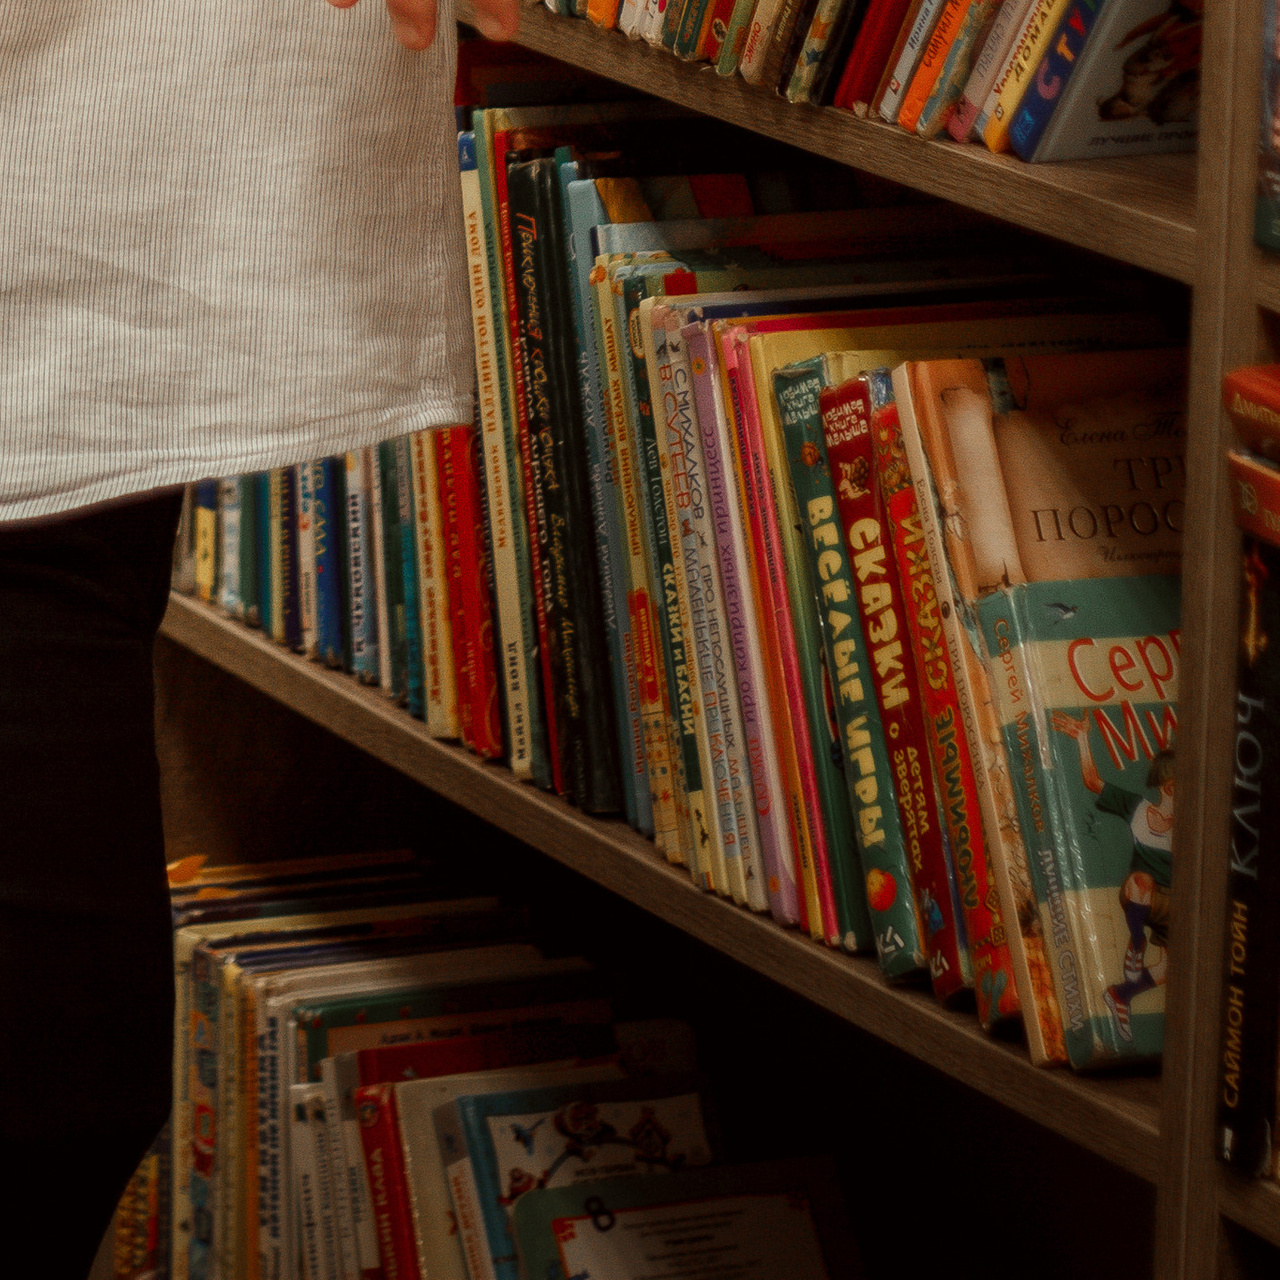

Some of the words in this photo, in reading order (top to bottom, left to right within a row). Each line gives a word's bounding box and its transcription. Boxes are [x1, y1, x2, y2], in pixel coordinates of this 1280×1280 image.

[908, 7, 930, 49] Ирина
[923, 10, 954, 67] Самуил
[468, 210, 481, 250] ДОМА
[602, 315, 620, 374] МЫШАТ
[611, 378, 628, 438] ВЕСЁЛЫХ
[644, 437, 660, 470] Лев
[1057, 416, 1128, 446] Елена
[620, 445, 642, 557] ПРИКЛЮЧЕНИЯ
[701, 426, 731, 534] принцесс
[659, 388, 692, 512] СУТЕЕВ
[684, 547, 714, 681] МАЛЕНЬКИЕ
[703, 689, 736, 846] ПРИКЛЮЧЕНИЯ
[662, 562, 682, 641] СКАЗКИ
[719, 543, 753, 671] капризных
[848, 516, 910, 711] СКАЗКИ
[899, 519, 948, 691] СКАЗКИ
[671, 647, 684, 661] и
[673, 662, 697, 737] БАСНИ
[699, 562, 717, 604] ПРО
[709, 606, 735, 750] НЕПОСЛУШНЫХ
[740, 679, 756, 723] про
[806, 495, 864, 706] ВЕСЁЛЫЕ
[846, 715, 887, 848] ИГРЫ
[946, 634, 961, 669] ТРИ
[993, 618, 1021, 704] Сергей
[1013, 708, 1048, 836] Михалков
[893, 749, 923, 874] зверятах
[906, 745, 930, 836] детям
[933, 704, 981, 909] ЛЮБИМЫЕ
[1229, 693, 1266, 882] КЛЮЧ
[1036, 848, 1071, 945] ЛУЧШИЕ
[1054, 949, 1085, 1034] СТИХИ
[1228, 901, 1249, 977] ТОЙН
[1224, 985, 1248, 1108] САЙМОН
